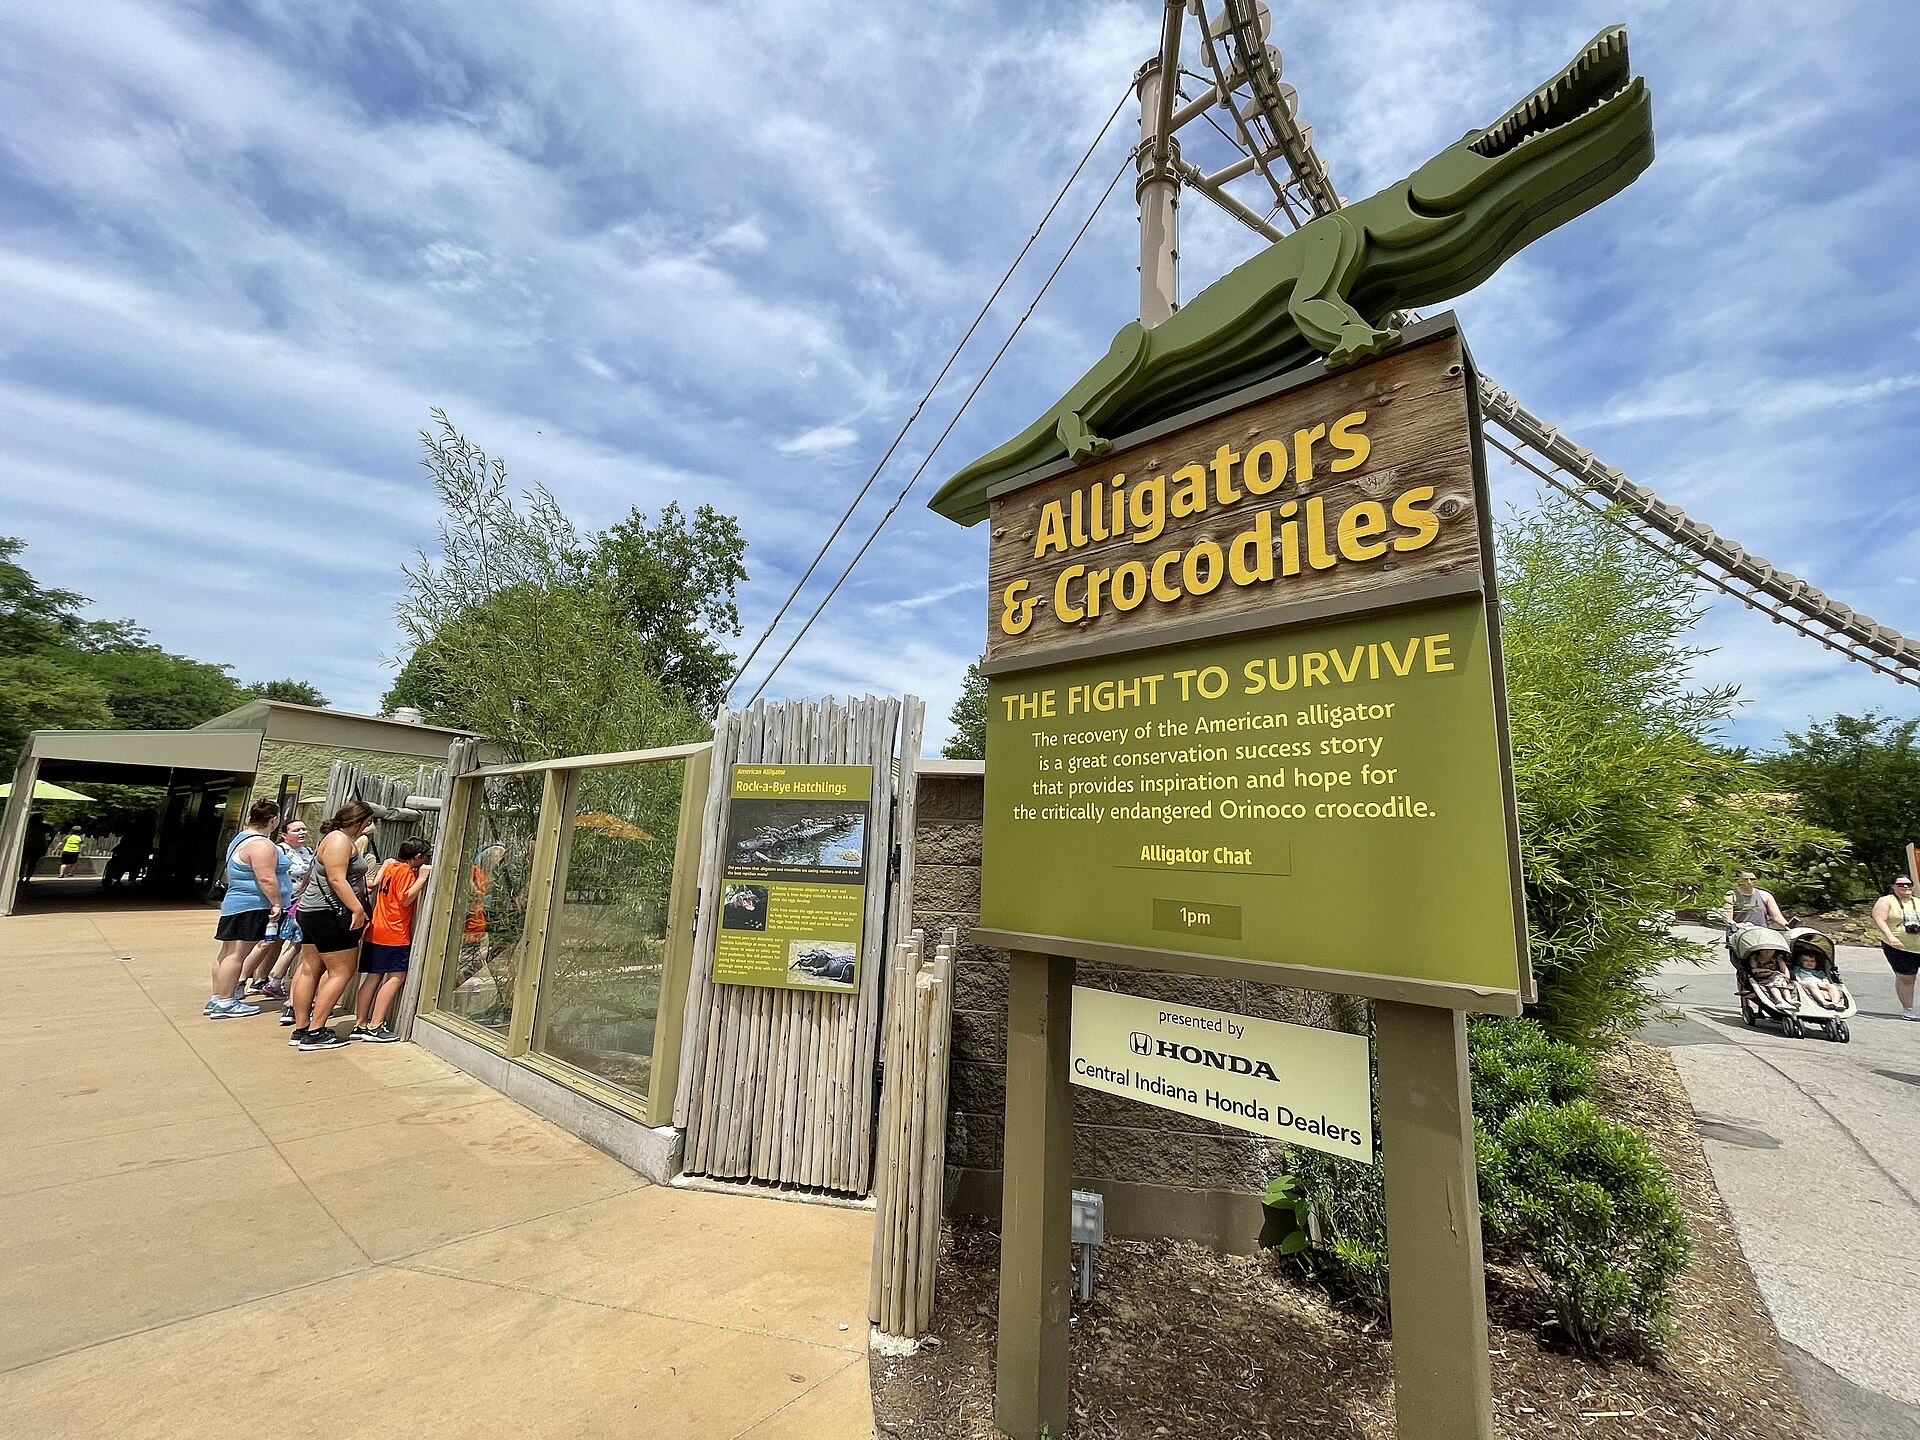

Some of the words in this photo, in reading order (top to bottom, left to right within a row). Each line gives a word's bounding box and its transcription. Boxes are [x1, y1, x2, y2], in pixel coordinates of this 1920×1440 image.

[1034, 411, 1371, 559] Alligators
[1001, 579, 1038, 635] &
[1054, 485, 1440, 623] Crocodiles
[1002, 689, 1056, 721] THE
[1068, 674, 1164, 715] FIGHT
[1173, 665, 1229, 701] TO
[1243, 633, 1455, 694] SURVIVE
[1032, 731, 1058, 748] The
[1063, 725, 1128, 751] recovery
[1134, 722, 1152, 740] of
[1158, 720, 1188, 738] the
[1195, 710, 1288, 735] American
[1296, 700, 1396, 730] alligator
[1039, 755, 1049, 771] is
[1054, 758, 1063, 770] a
[1068, 753, 1107, 773] great
[1113, 745, 1228, 767] conservation
[1235, 740, 1312, 759] success
[1320, 734, 1384, 759] story
[736, 781, 790, 794] Rock-a-Bye
[793, 781, 847, 795] Hatchlings
[1032, 779, 1063, 796] that
[1068, 776, 1134, 799] provides
[1140, 774, 1238, 797] inspiration
[1246, 768, 1285, 788] and
[1294, 768, 1350, 791] hope
[1361, 764, 1397, 785] for
[1013, 804, 1037, 820] the
[1041, 803, 1105, 824] critically
[1110, 801, 1212, 824] endangered
[1219, 799, 1306, 820] Orinoco
[1314, 796, 1436, 819] crocodile.
[1140, 845, 1208, 866] Alligator
[1213, 846, 1252, 865] Chat
[1179, 907, 1211, 927] 1pm
[1159, 1010, 1222, 1033] presented
[1227, 1015, 1245, 1039] by
[1155, 1040, 1280, 1082] HONDA
[1074, 1057, 1129, 1087] Central
[1135, 1071, 1197, 1103] Indiana
[1205, 1088, 1269, 1123] Honda
[1277, 1106, 1362, 1146] Dealers
